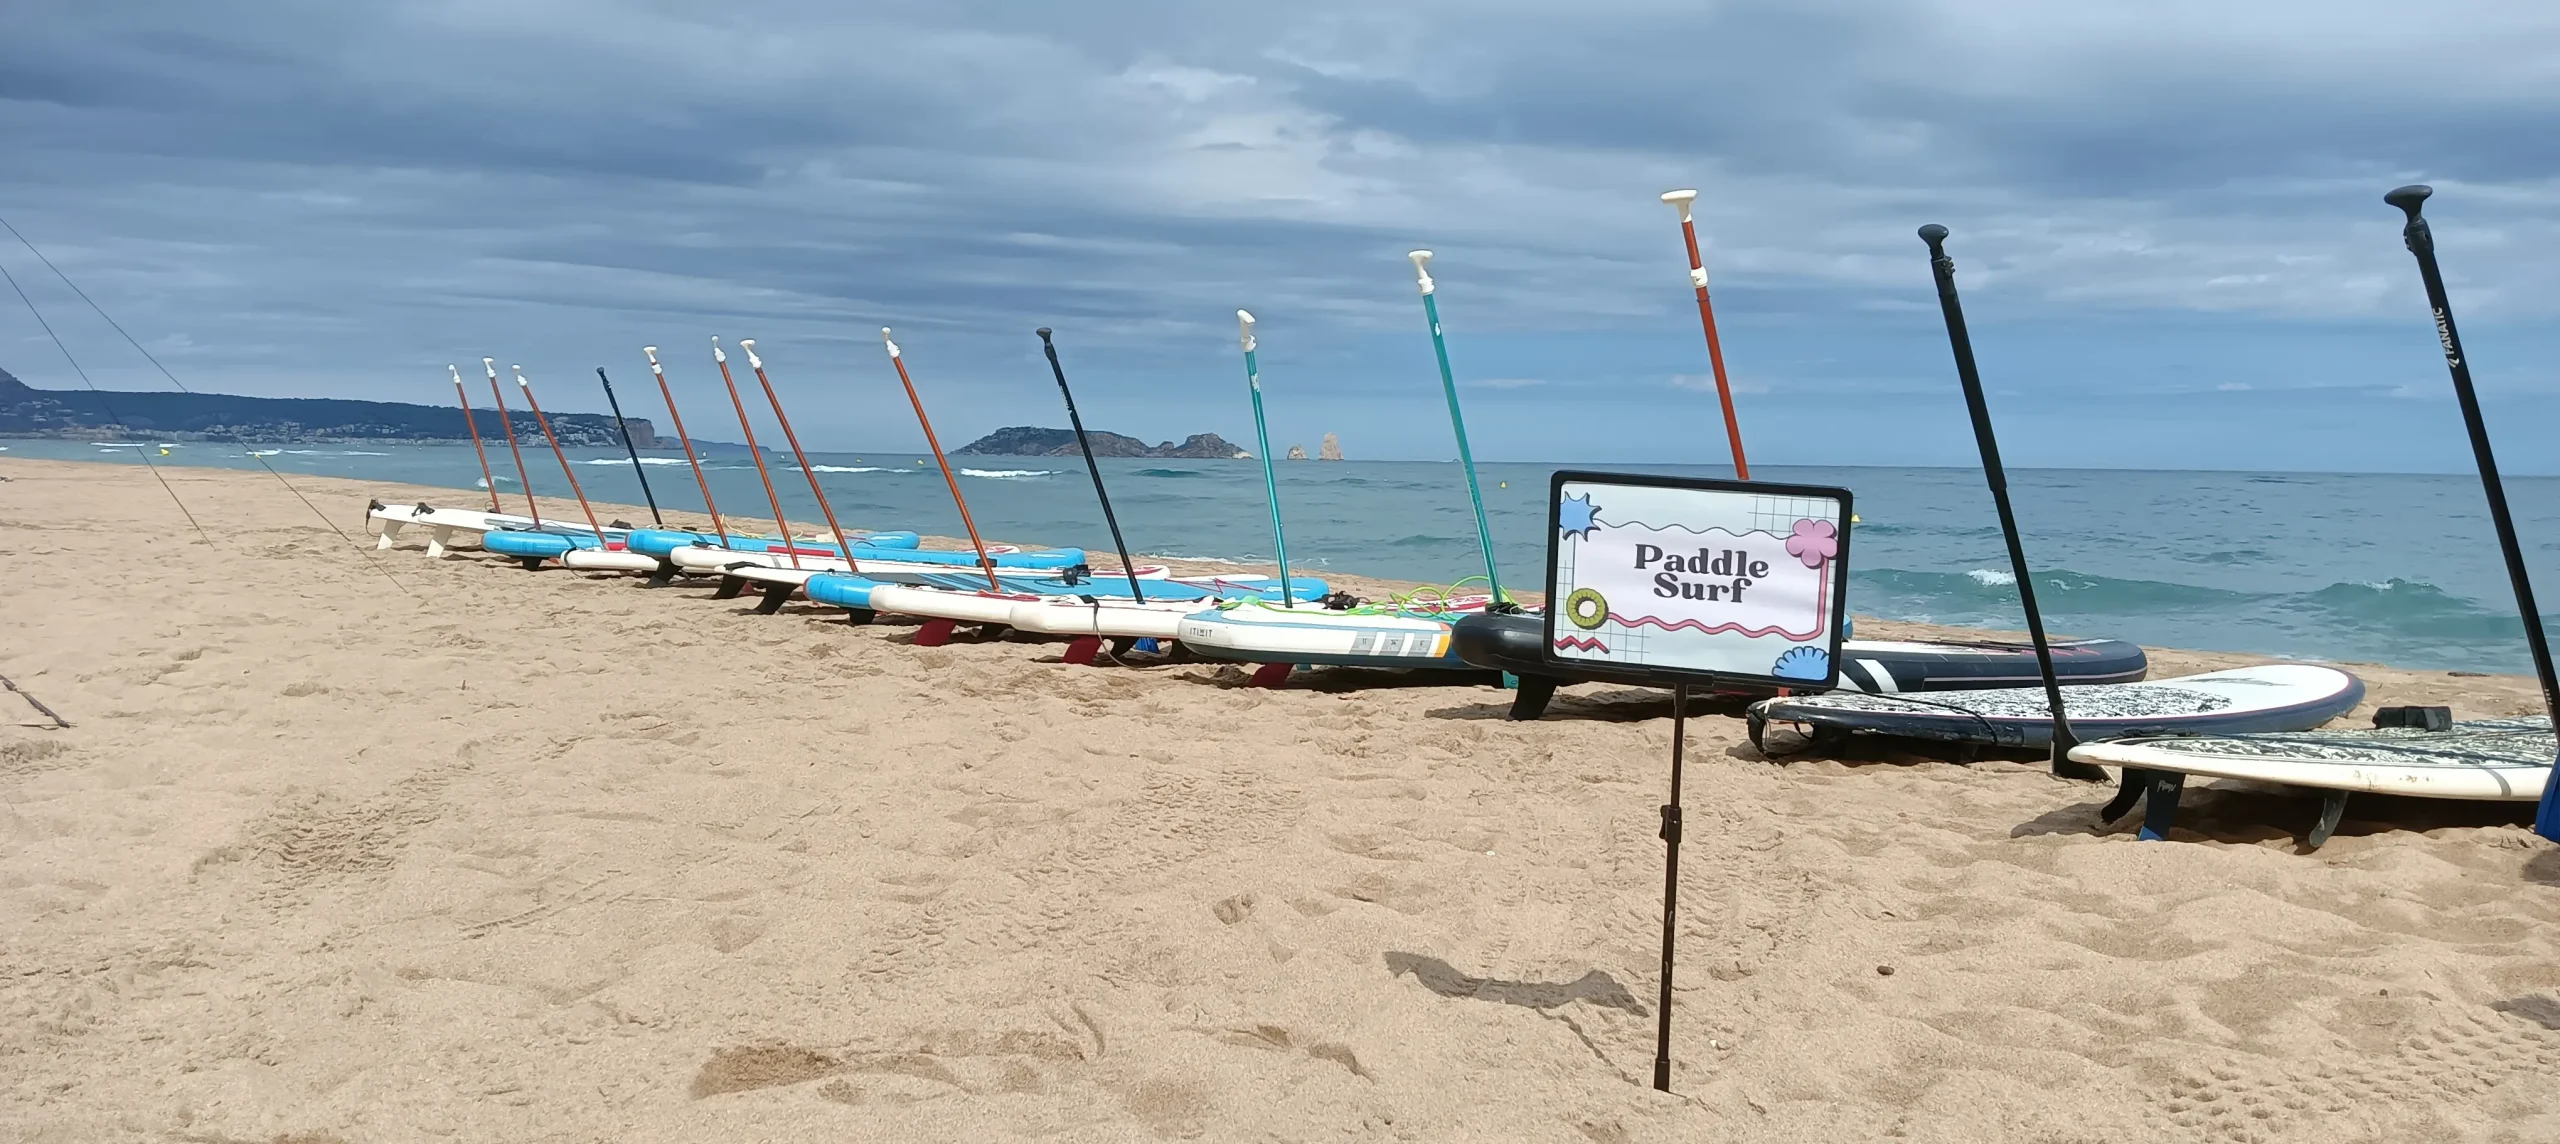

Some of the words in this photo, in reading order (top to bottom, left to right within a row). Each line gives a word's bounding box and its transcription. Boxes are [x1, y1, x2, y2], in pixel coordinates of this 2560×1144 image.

[2432, 306, 2455, 355] FANATIC
[1633, 543, 1770, 578] Paddle
[1653, 572, 1753, 604] Surf
